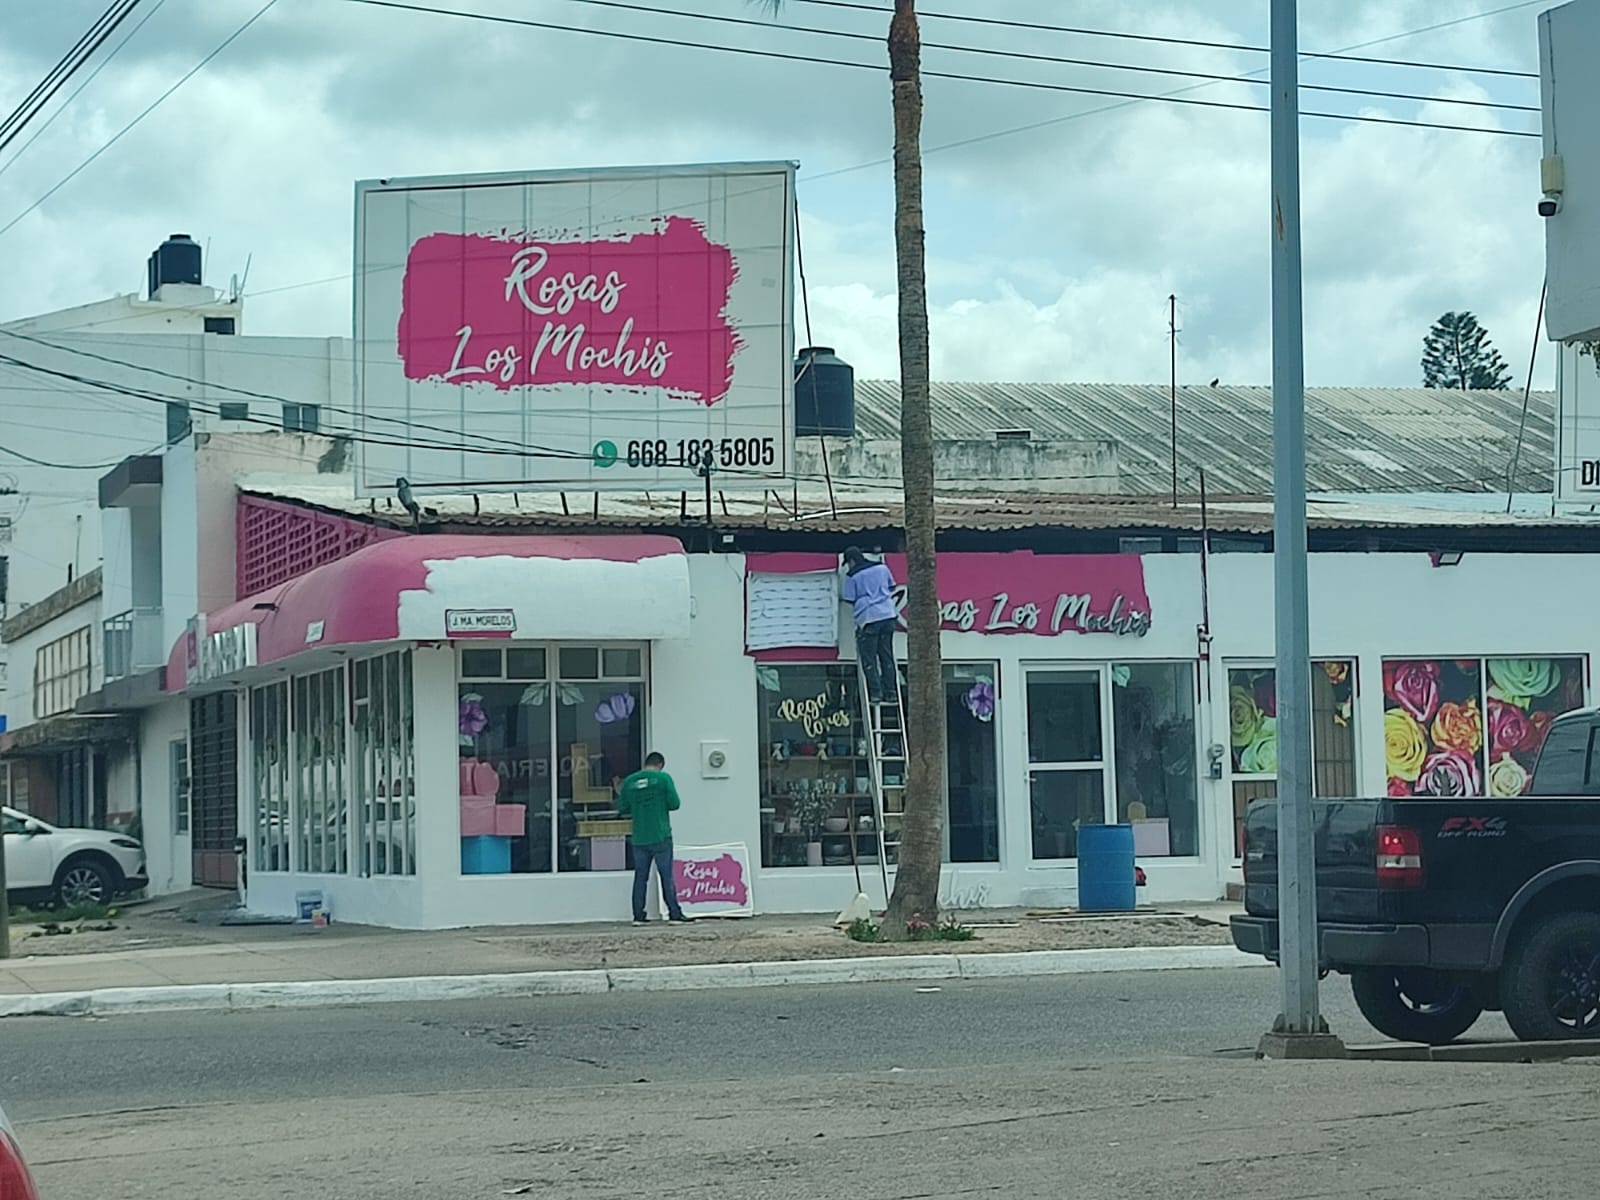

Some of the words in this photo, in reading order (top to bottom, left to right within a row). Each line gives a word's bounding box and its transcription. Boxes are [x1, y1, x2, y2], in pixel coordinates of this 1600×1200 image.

[504, 246, 627, 315] Rosas
[443, 325, 522, 382] Los
[530, 317, 673, 378] Mochis
[628, 440, 667, 467] 668
[720, 438, 774, 466] 5805
[476, 615, 512, 626] MORELOS
[984, 592, 1041, 630] Los
[1050, 593, 1149, 637] Mochis
